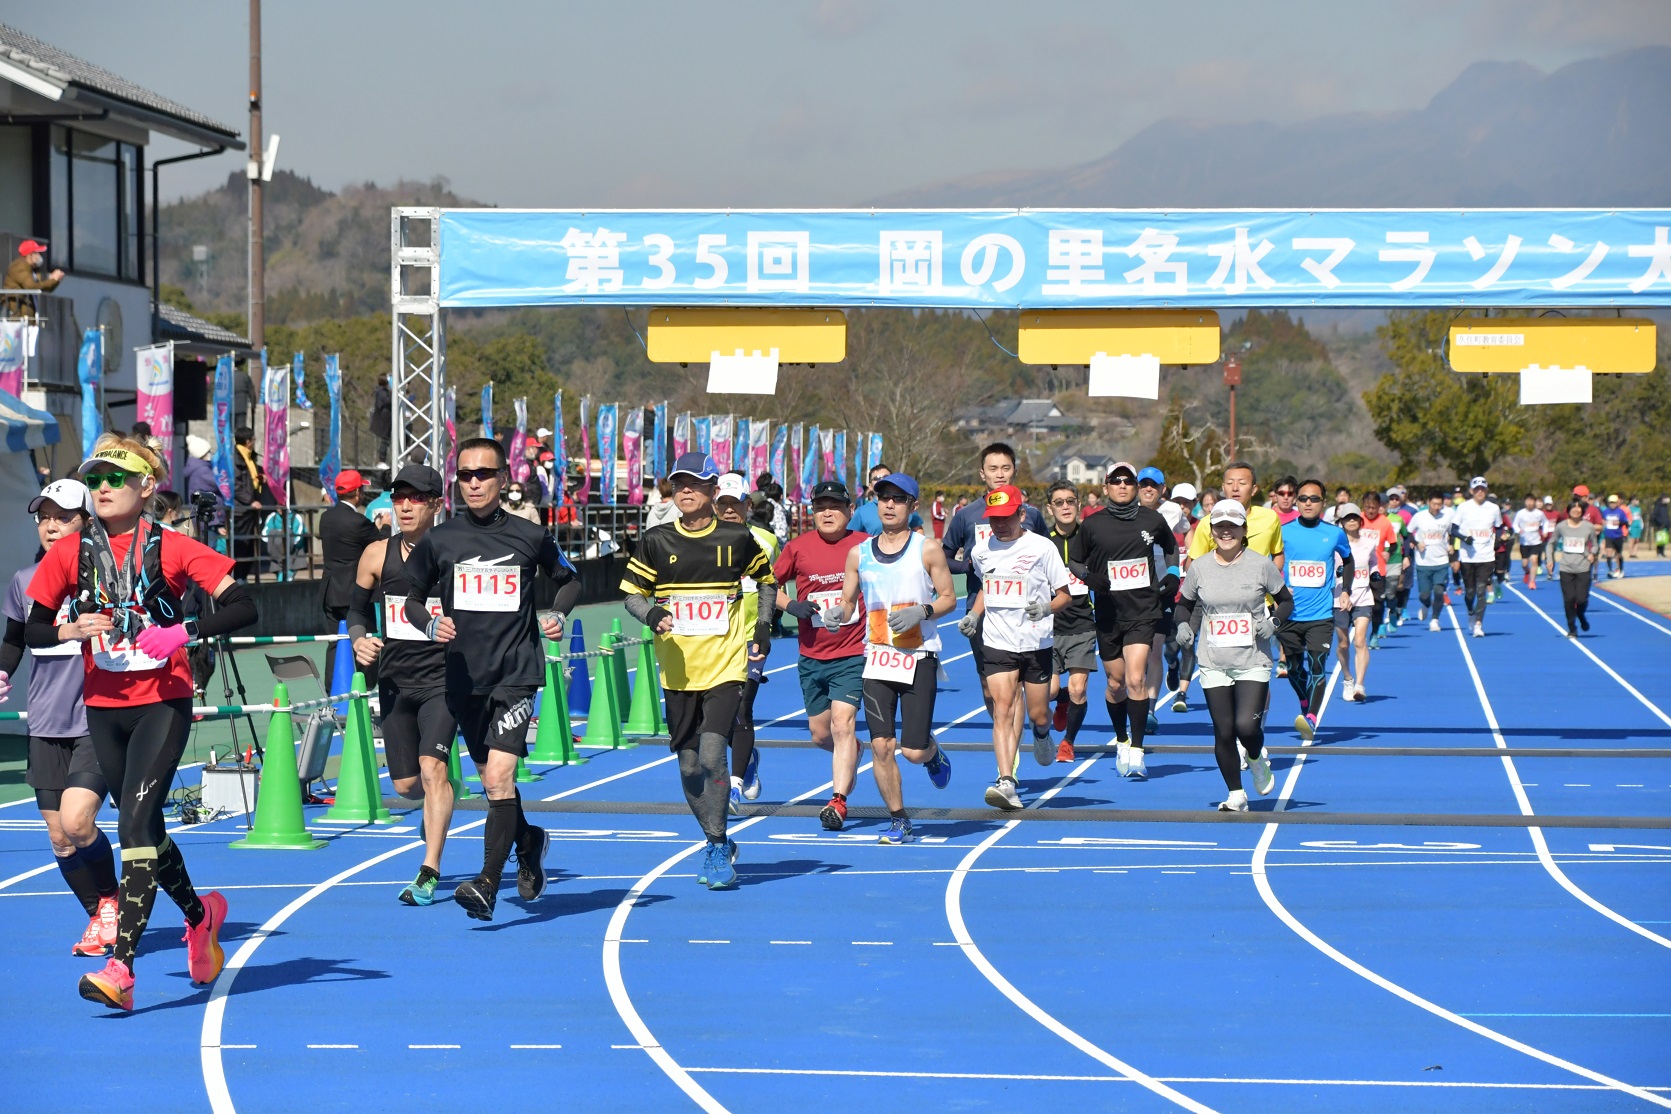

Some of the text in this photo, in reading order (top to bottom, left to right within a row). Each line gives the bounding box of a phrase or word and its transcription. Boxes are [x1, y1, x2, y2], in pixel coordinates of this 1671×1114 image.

[561, 226, 811, 296] 第35回
[1111, 562, 1147, 580] 1067
[1291, 565, 1325, 578] 1089
[458, 573, 518, 595] 1115
[985, 579, 1023, 596] 1171
[673, 600, 725, 621] 1107
[1208, 619, 1250, 636] 1203
[871, 650, 915, 670] 1050
